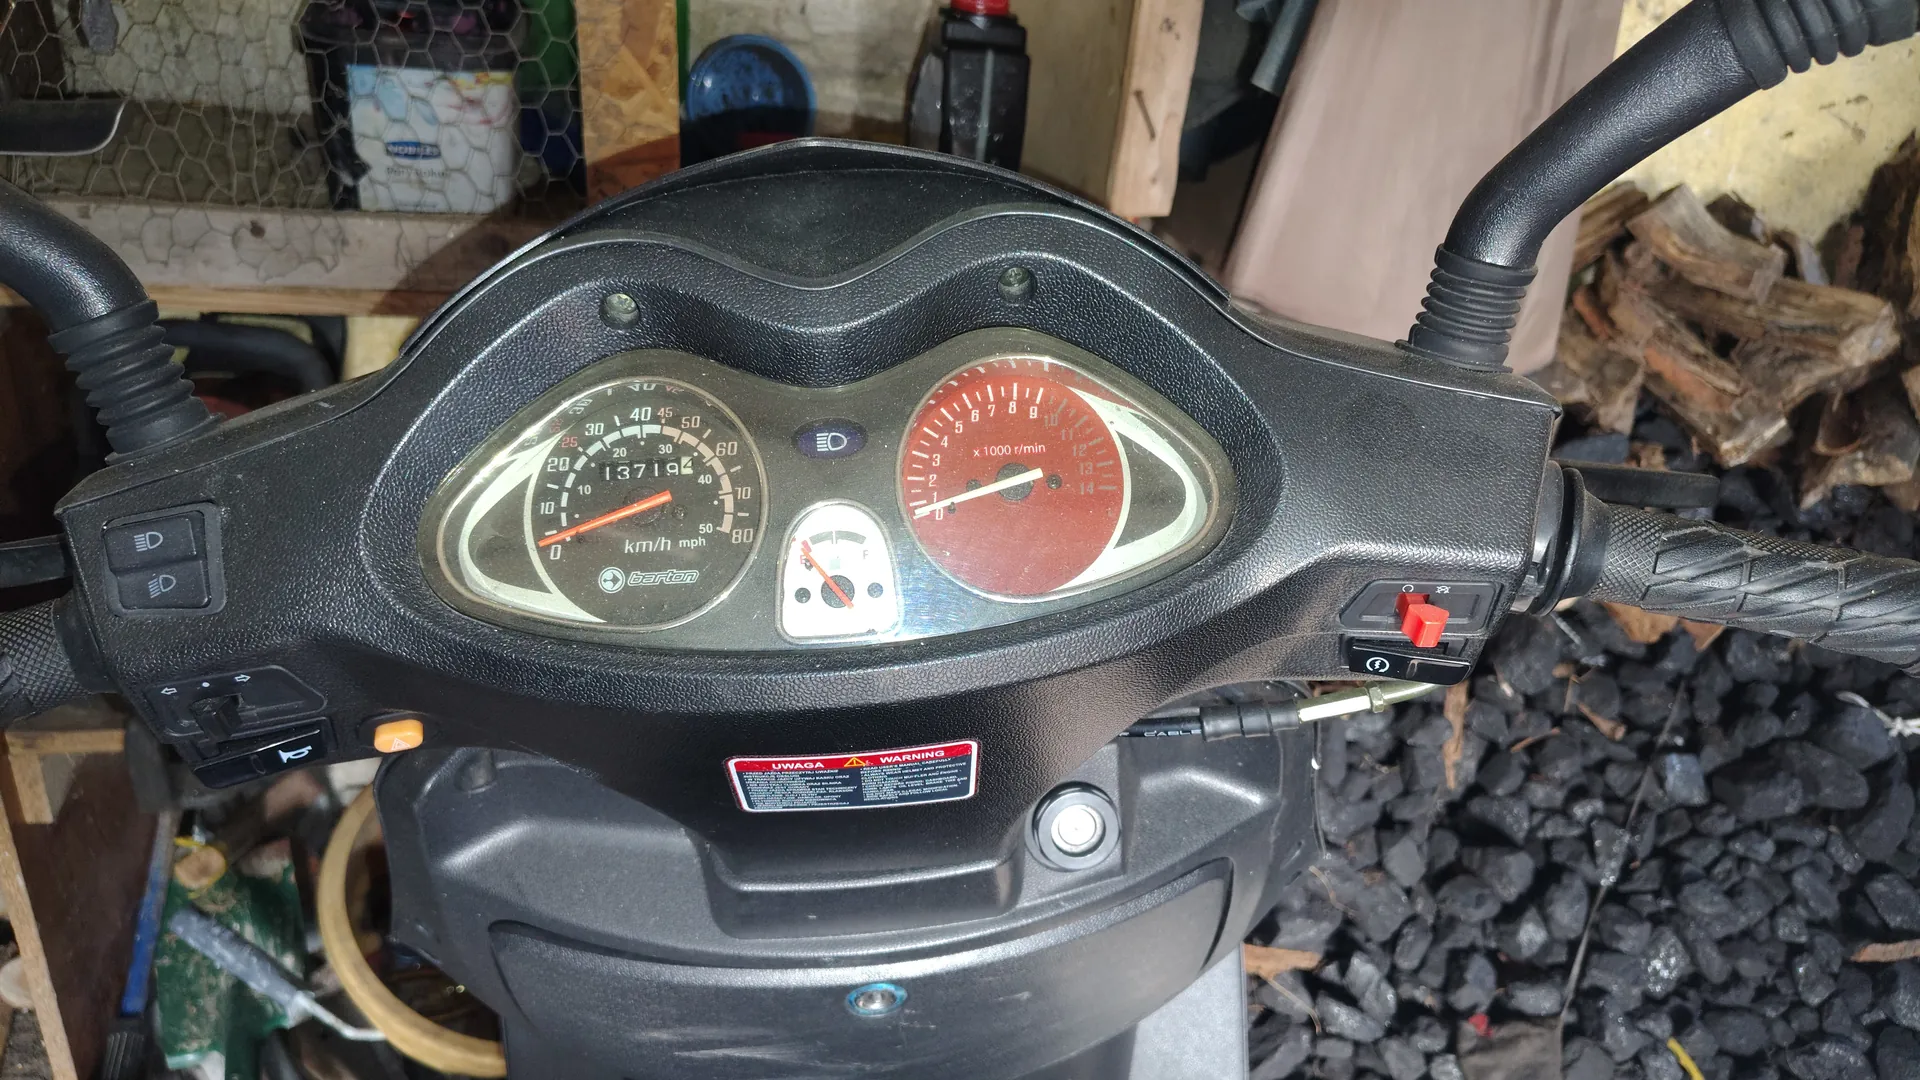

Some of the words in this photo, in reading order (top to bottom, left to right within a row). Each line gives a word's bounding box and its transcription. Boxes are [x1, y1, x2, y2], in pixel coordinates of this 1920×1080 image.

[657, 407, 673, 418] 45
[988, 404, 996, 417] 7
[1008, 401, 1016, 414] 8
[1030, 406, 1038, 419] 9
[630, 407, 652, 422] 40
[971, 410, 979, 422] 6
[1044, 414, 1058, 427] 10
[681, 416, 700, 428] 50
[955, 421, 963, 434] 5
[585, 422, 605, 436] 30
[1061, 428, 1073, 441] 11
[561, 436, 578, 448] 25
[940, 436, 948, 448] 4
[612, 448, 627, 458] 20
[658, 444, 673, 454] 30
[716, 442, 738, 456] 60
[973, 449, 980, 457] x
[984, 445, 1012, 456] 1000
[1014, 443, 1046, 455] r/min
[1072, 444, 1087, 457] 12
[547, 457, 570, 472] 20
[932, 454, 940, 466] 3
[1080, 462, 1093, 475] 13
[698, 474, 712, 484] 40
[928, 474, 937, 487] 2
[577, 485, 592, 495] 10
[735, 487, 751, 500] 70
[1080, 482, 1094, 495] 14
[932, 492, 938, 503] 1
[540, 502, 554, 515] 10
[936, 507, 944, 520] 0
[698, 524, 713, 534] 50
[732, 529, 754, 544] 80
[550, 545, 562, 560] 0
[624, 538, 672, 554] km/h
[678, 538, 706, 550] mph
[628, 569, 699, 586] barton
[771, 761, 825, 770] UWAGA
[880, 750, 945, 763] WARNING
